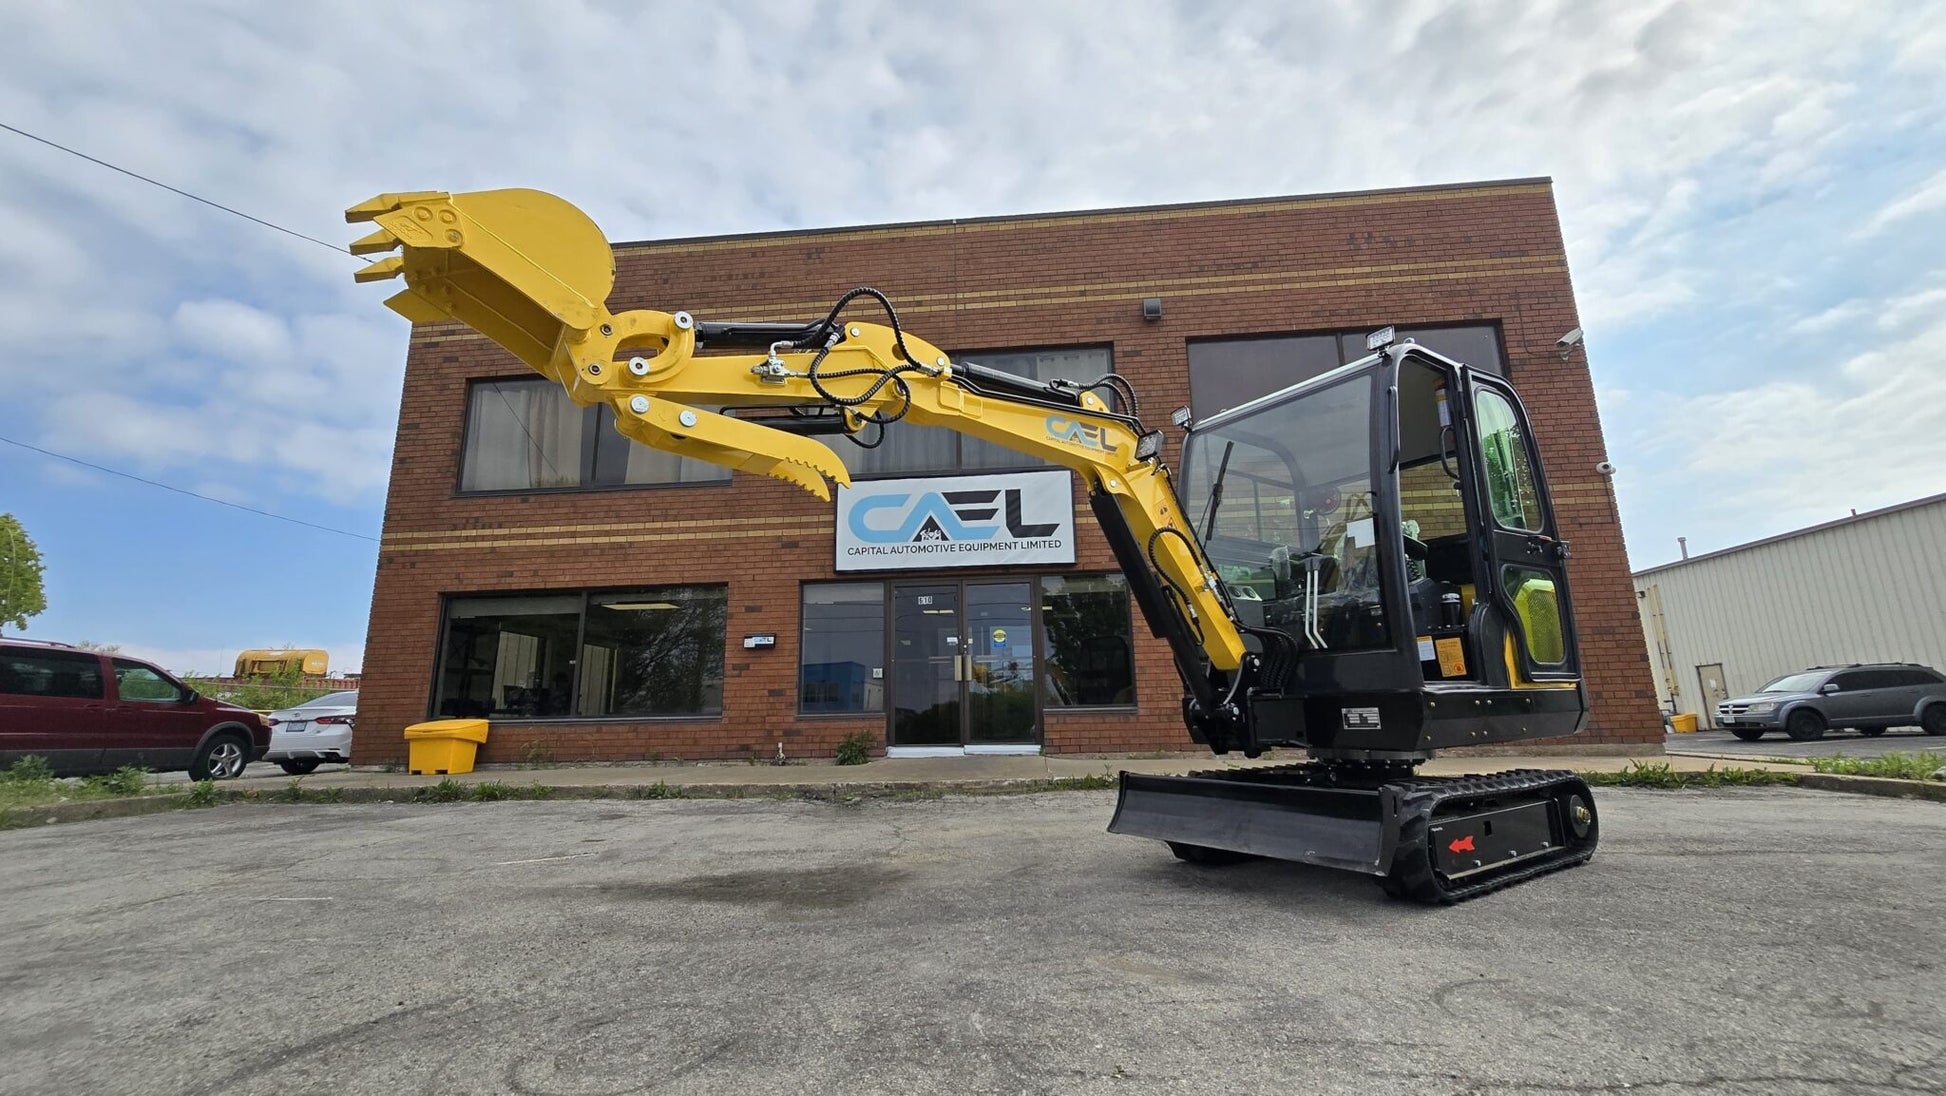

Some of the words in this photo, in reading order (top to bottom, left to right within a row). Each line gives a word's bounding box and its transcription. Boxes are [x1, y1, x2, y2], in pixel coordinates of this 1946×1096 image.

[1046, 415, 1118, 452] CAEL
[848, 489, 1060, 543] CAEL
[847, 546, 888, 556] CAPITAL
[890, 544, 956, 555] AUTOMOTIVE
[959, 541, 1018, 552] EQUIPMENT
[1020, 540, 1062, 550] LIMITED
